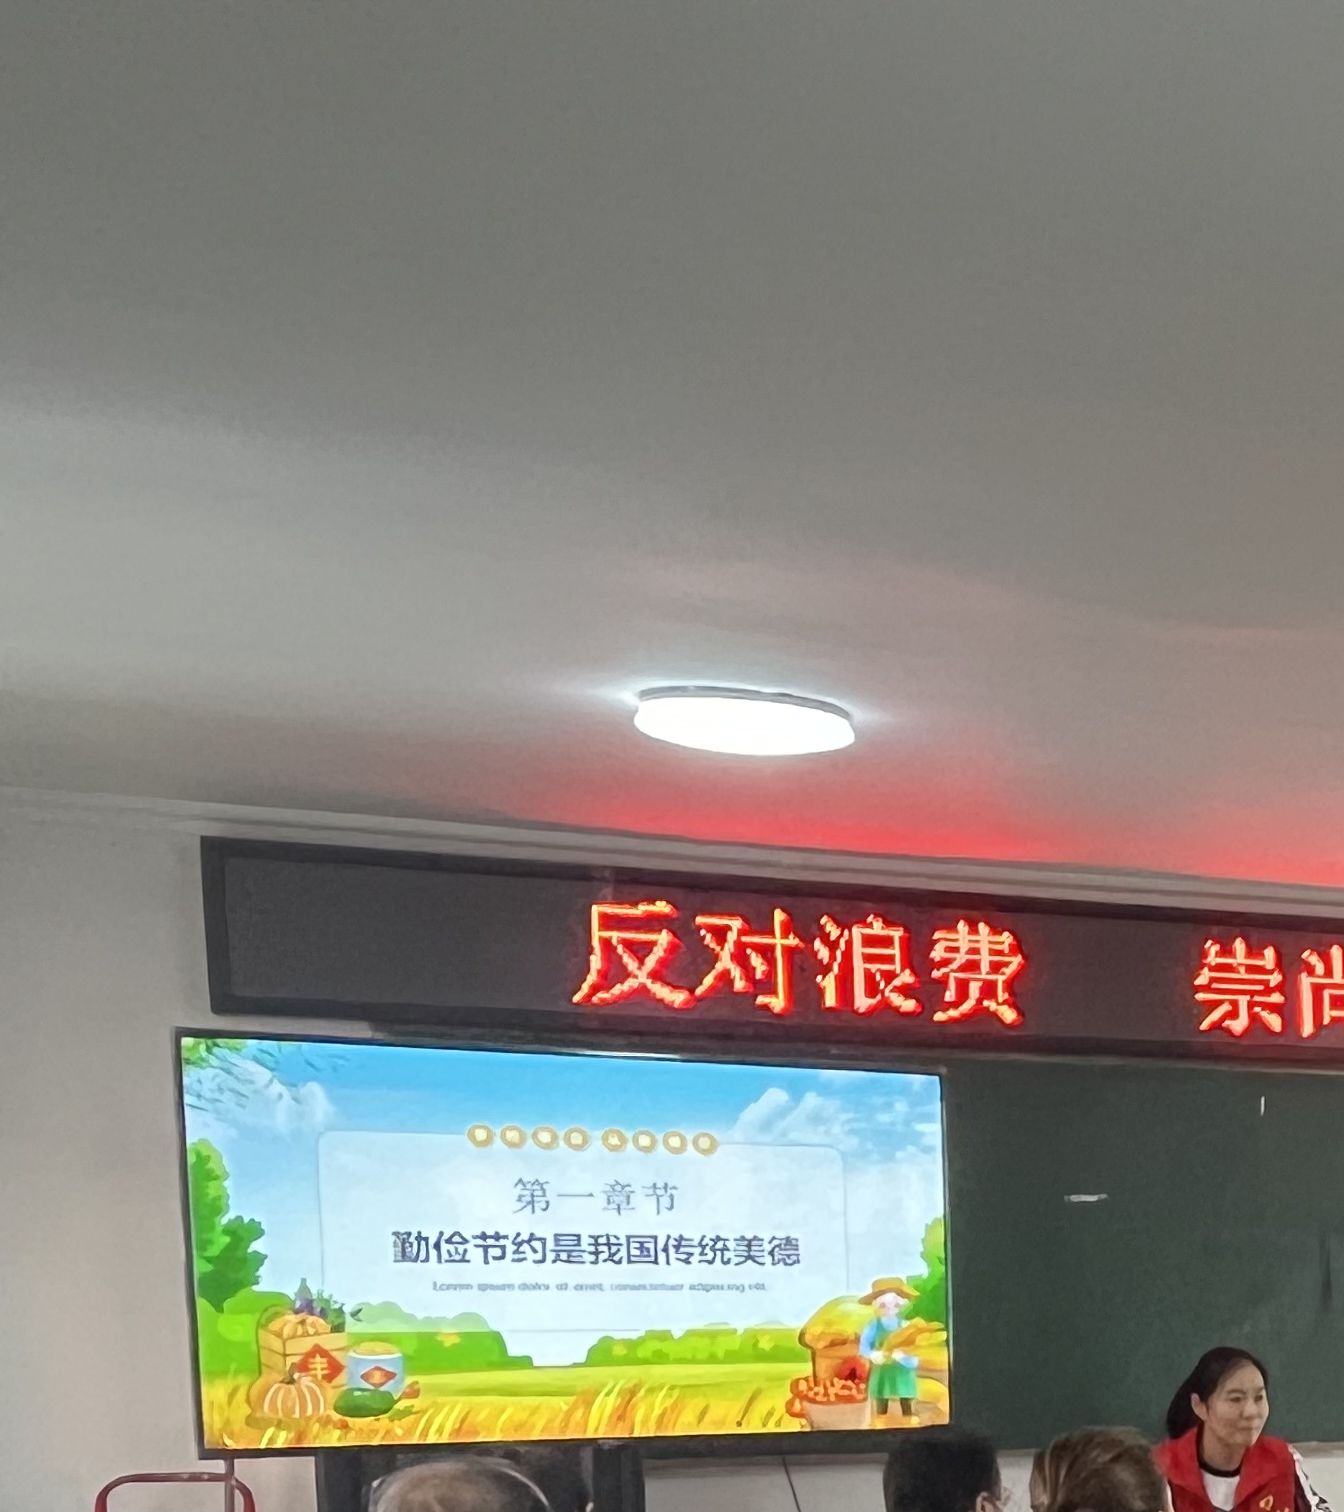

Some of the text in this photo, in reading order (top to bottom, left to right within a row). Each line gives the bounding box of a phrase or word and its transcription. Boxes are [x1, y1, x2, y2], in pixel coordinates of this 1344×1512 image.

[572, 900, 1026, 1026] 反对浪费
[512, 1177, 680, 1215] 第一章节
[391, 1230, 802, 1267] 勤俭节约是我国传统美德
